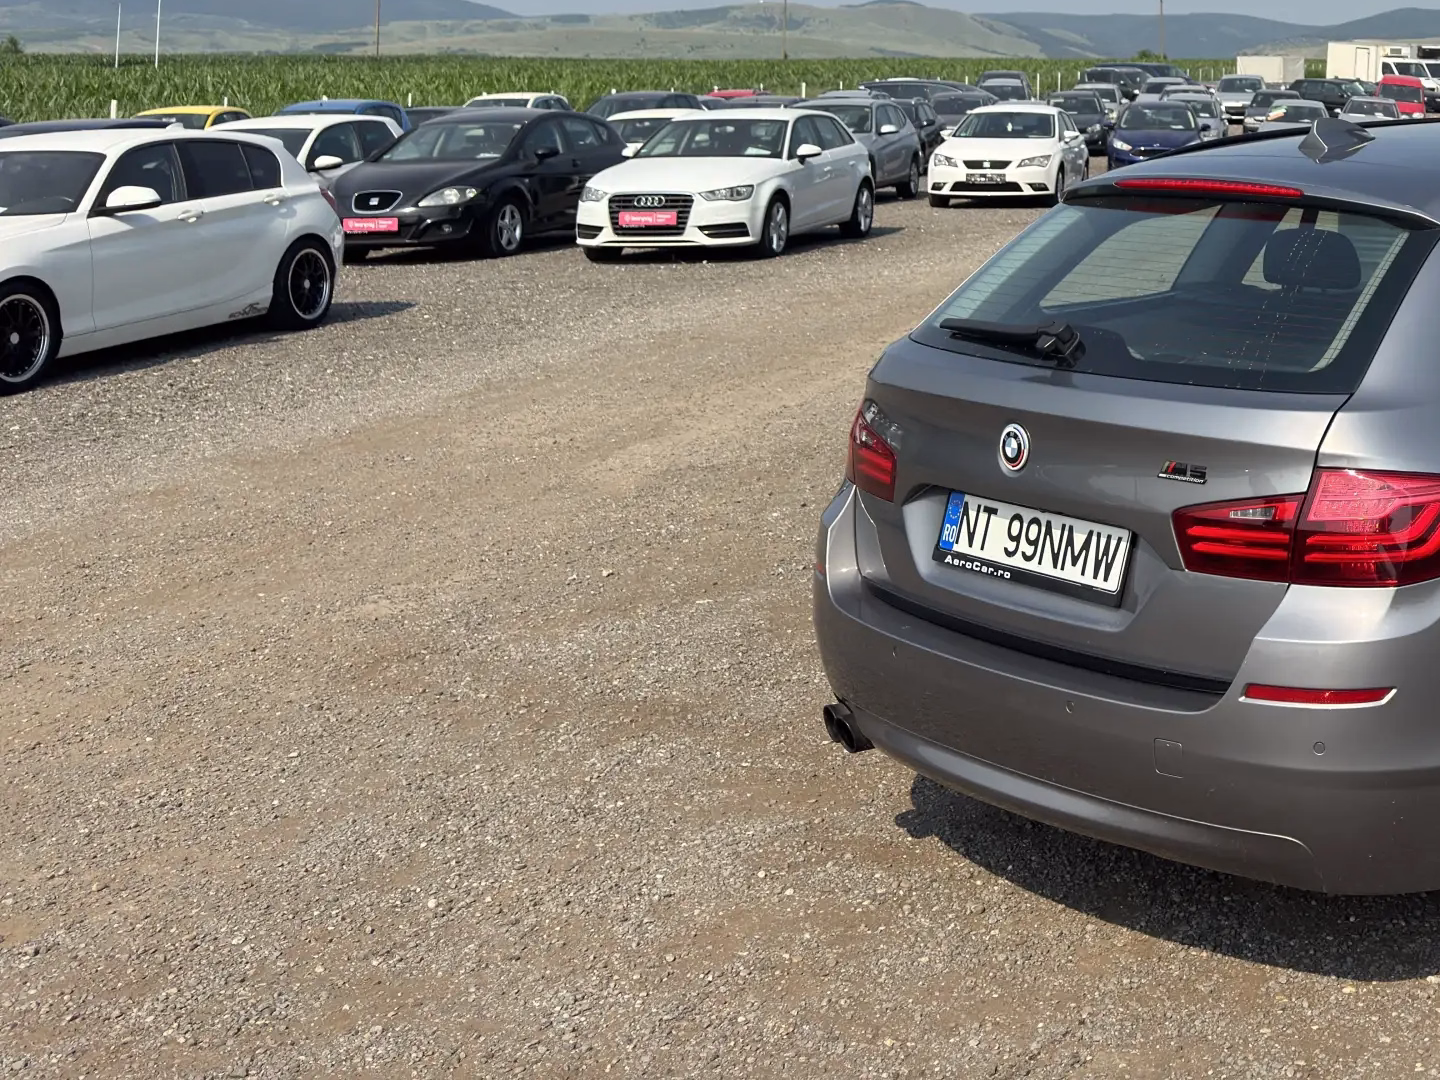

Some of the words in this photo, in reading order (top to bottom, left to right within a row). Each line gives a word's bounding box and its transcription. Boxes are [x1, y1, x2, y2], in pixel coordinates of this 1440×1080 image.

[1166, 474, 1204, 483] competition
[942, 523, 957, 543] RO
[955, 501, 998, 551] NT
[1003, 512, 1123, 583] 99NMW
[944, 554, 1011, 579] AeroCar.ro
